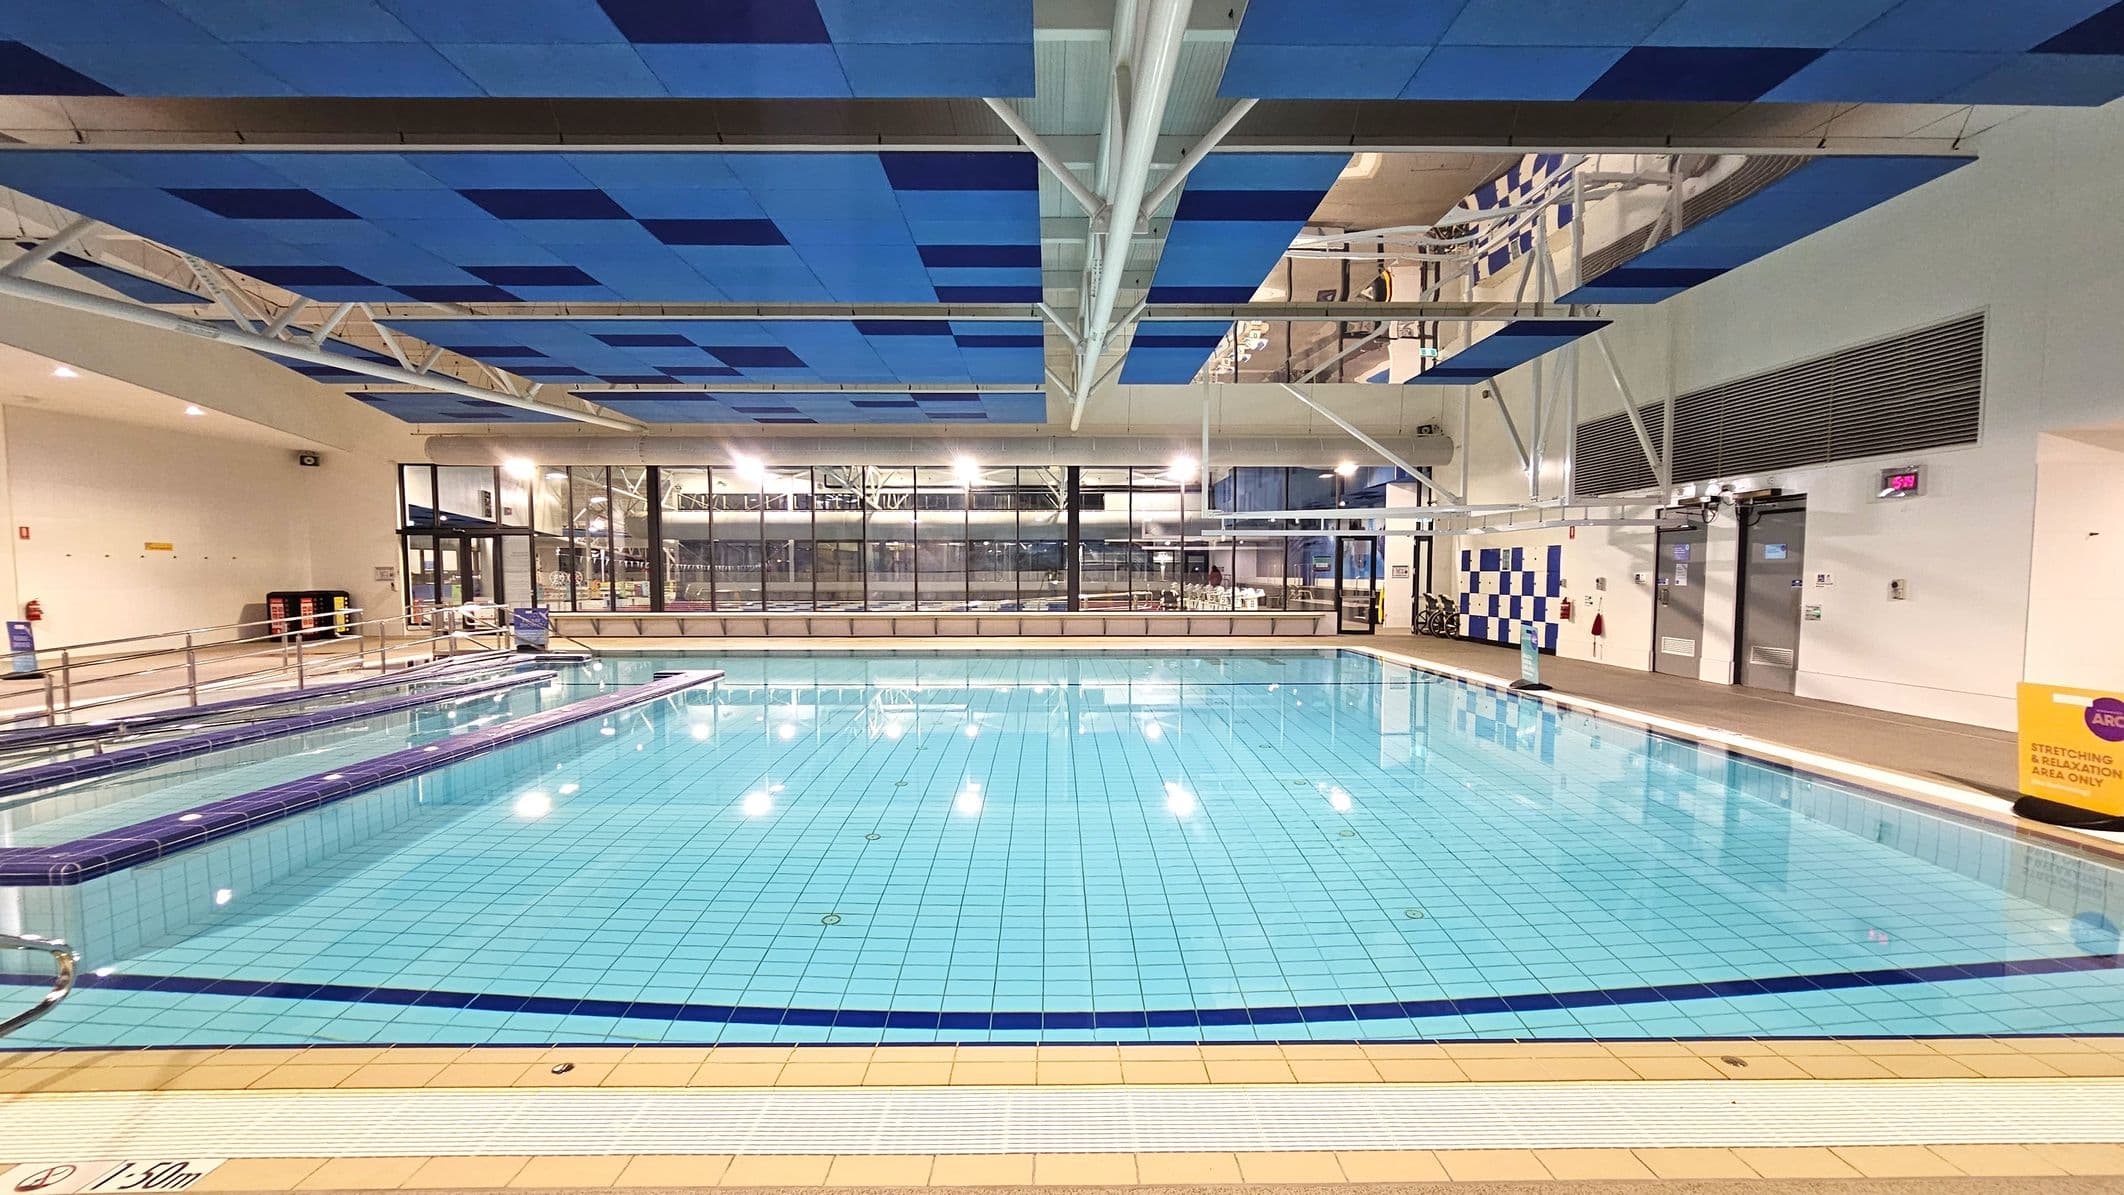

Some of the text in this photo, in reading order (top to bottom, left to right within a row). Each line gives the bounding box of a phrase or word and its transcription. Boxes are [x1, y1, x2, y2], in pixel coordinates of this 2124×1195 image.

[2031, 742, 2113, 765] STRETCHING
[2031, 754, 2123, 780] & RELAXATION
[2031, 766, 2104, 787] AREA ONLY
